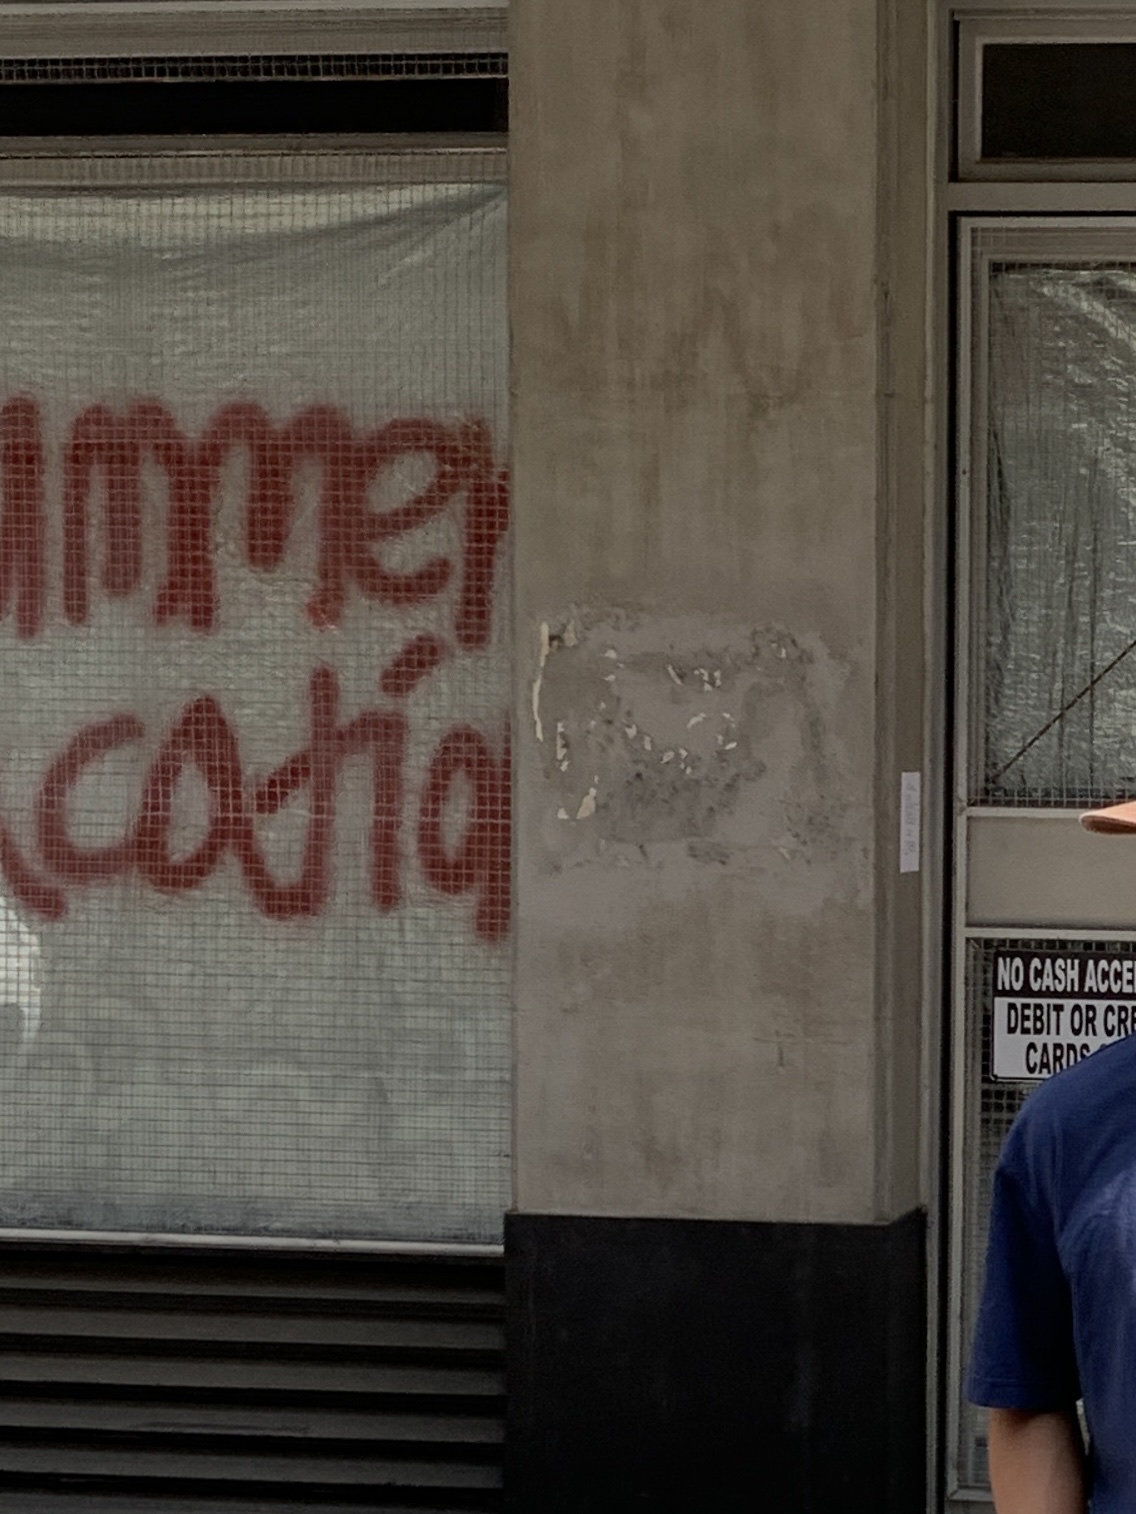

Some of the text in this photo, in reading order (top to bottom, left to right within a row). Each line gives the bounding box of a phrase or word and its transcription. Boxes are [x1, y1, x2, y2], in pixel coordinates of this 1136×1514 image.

[997, 956, 1024, 991] NO
[1029, 957, 1079, 992] CASH
[1007, 1002, 1064, 1035] DEBIT
[1070, 1003, 1098, 1037] OR
